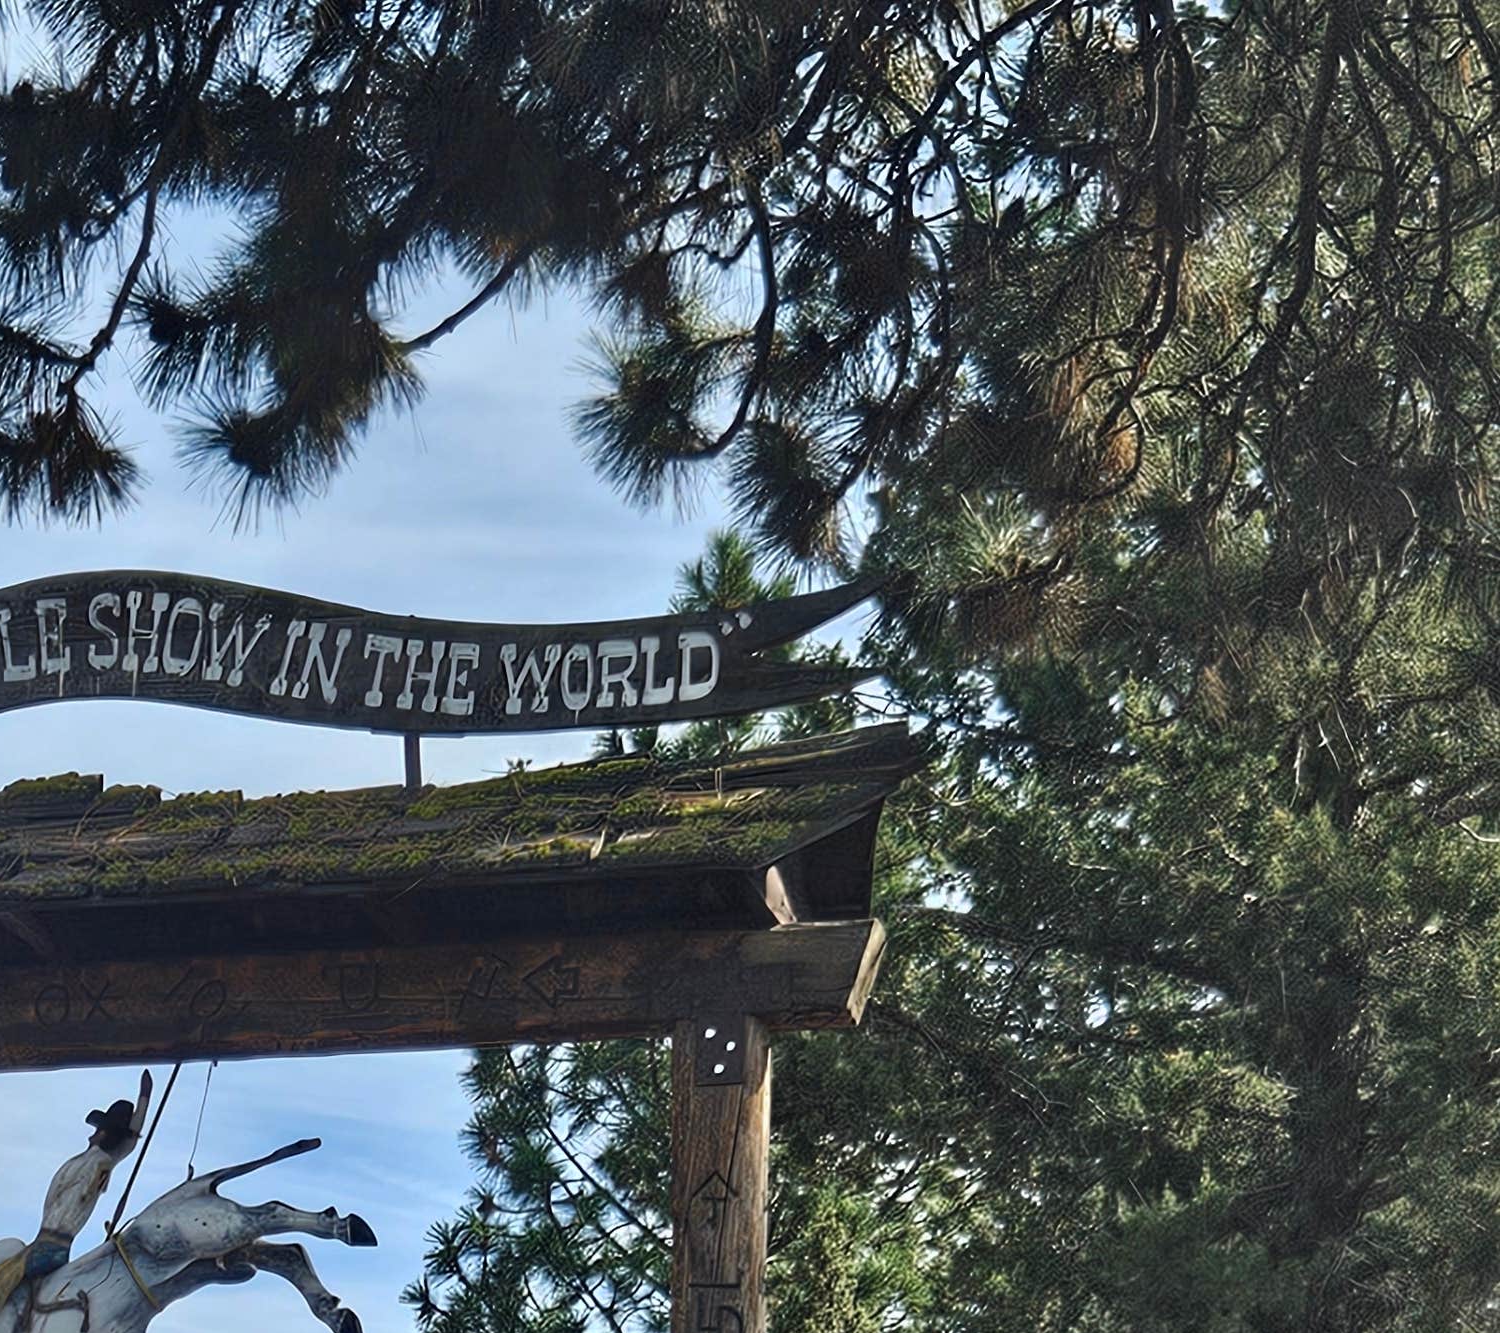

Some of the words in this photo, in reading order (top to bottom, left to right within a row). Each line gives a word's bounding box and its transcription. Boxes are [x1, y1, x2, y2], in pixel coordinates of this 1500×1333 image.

[86, 589, 273, 688] SHOW
[270, 620, 352, 706] IN
[363, 634, 480, 717] THE
